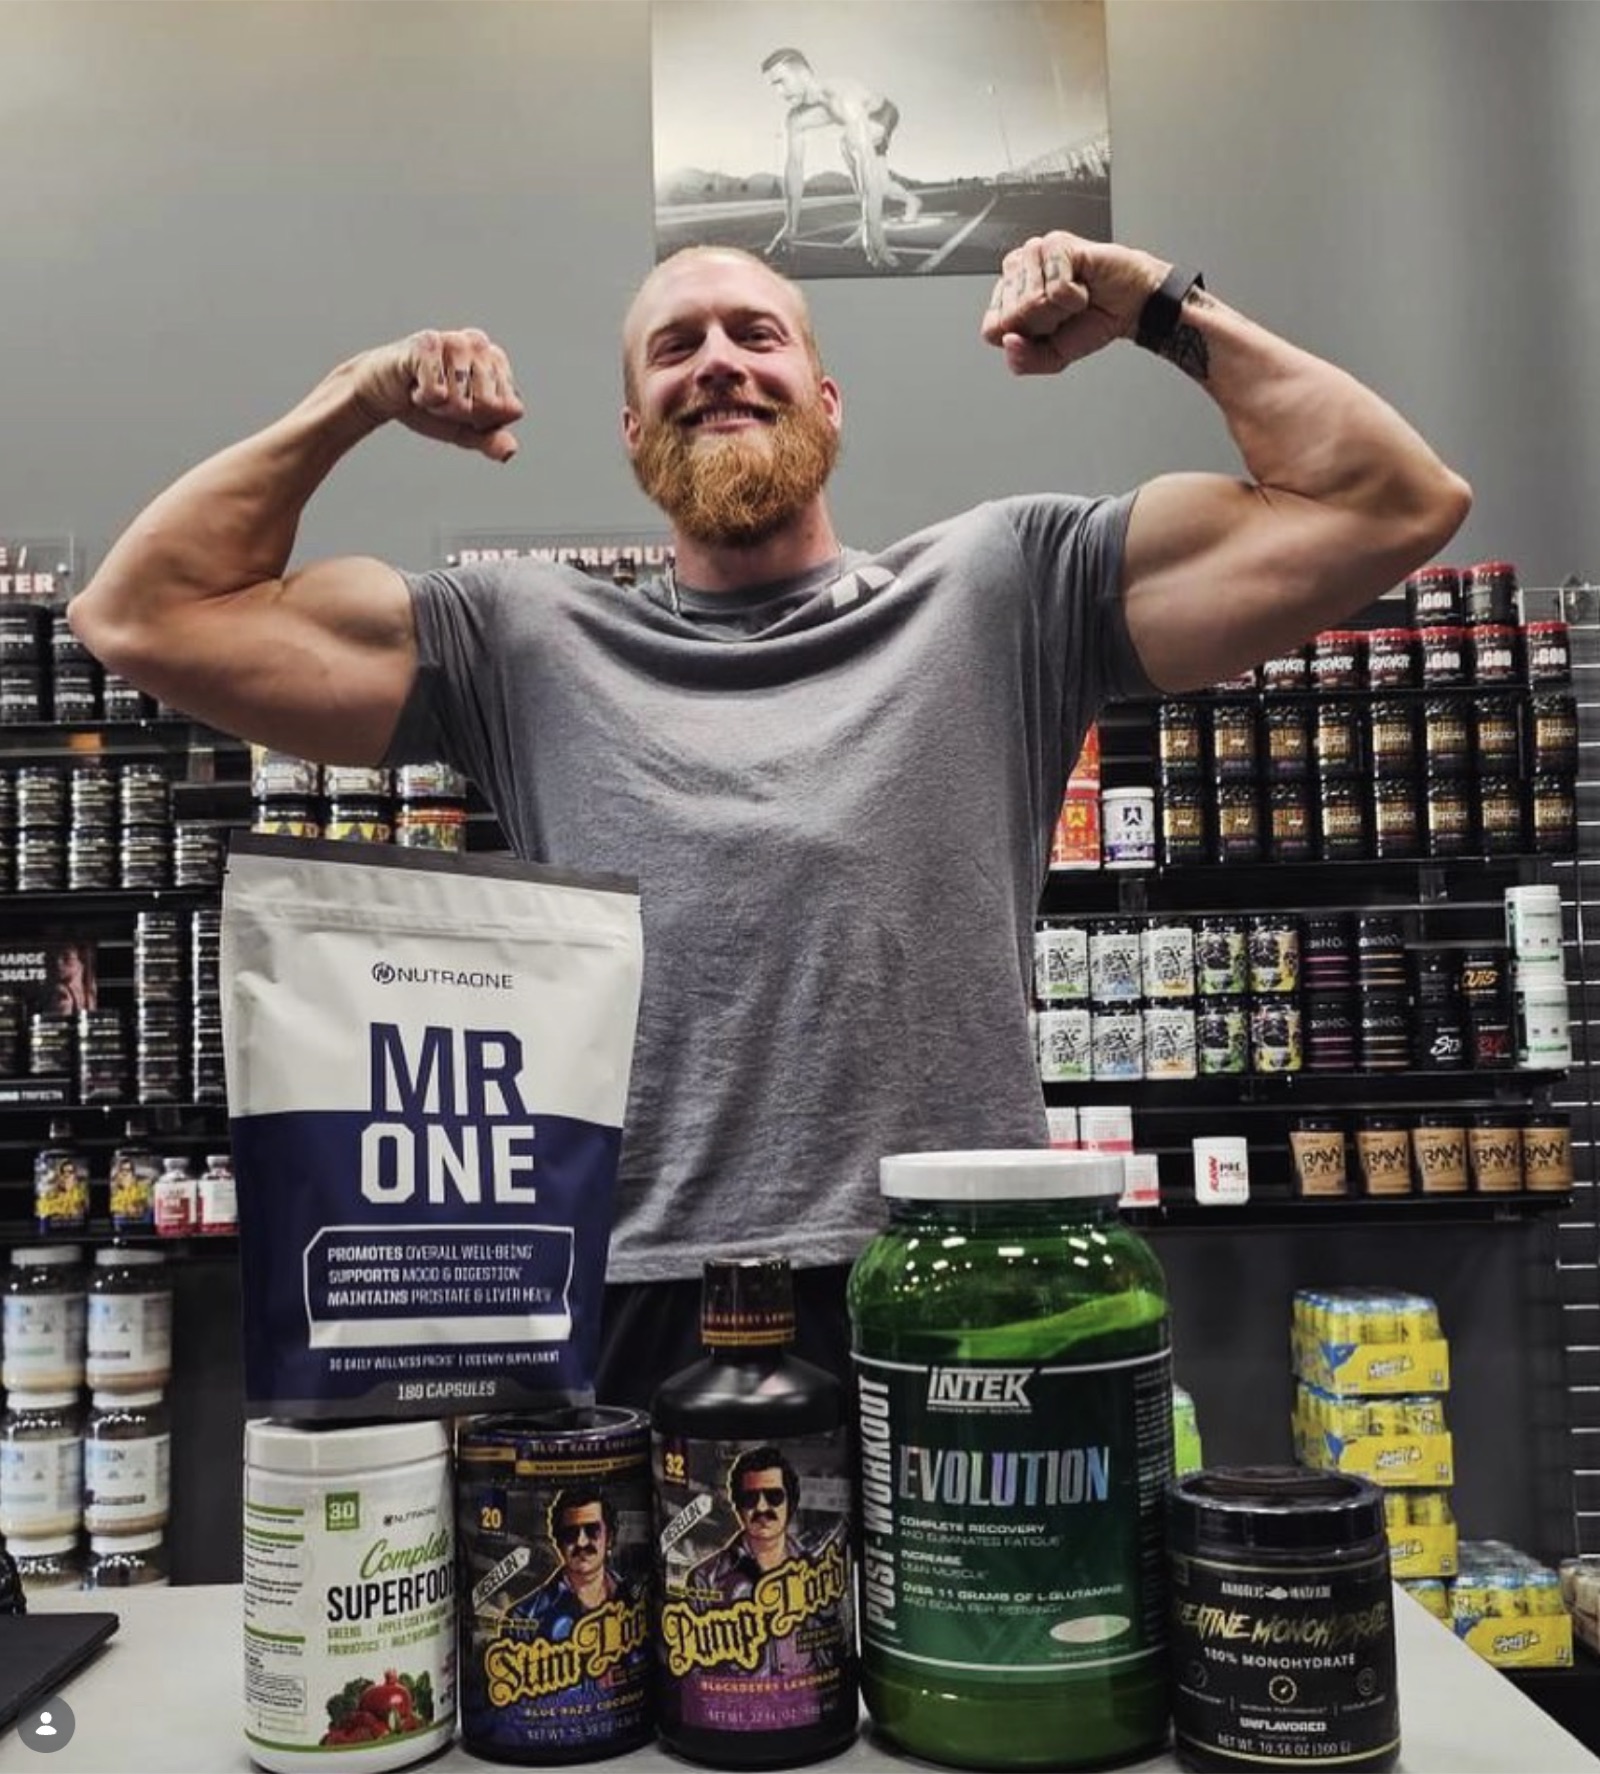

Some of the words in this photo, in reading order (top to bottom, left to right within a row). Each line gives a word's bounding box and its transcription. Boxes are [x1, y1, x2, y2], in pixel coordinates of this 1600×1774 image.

[397, 967, 513, 990] NUTRAONE
[369, 1021, 529, 1117] MR
[360, 1122, 537, 1205] ONE
[327, 1246, 404, 1263] PROMOTES
[405, 1245, 459, 1261] OVERALL
[328, 1268, 401, 1285] SUPPORTS
[402, 1267, 440, 1283] MOOD
[327, 1290, 409, 1307] MAINTAINS
[411, 1289, 471, 1305] PROSTATE
[485, 1288, 521, 1303] LIVER
[397, 1383, 424, 1401] 180
[425, 1380, 497, 1399] CAPSULES
[927, 1366, 1032, 1408] INTEK
[664, 1452, 685, 1477] 32
[899, 1445, 1111, 1507] EVOLUTION
[329, 1500, 356, 1520] 30
[481, 1506, 503, 1530] 20
[900, 1515, 964, 1533] COMPLETE
[968, 1522, 1046, 1535] RECOVERY
[901, 1549, 963, 1567] INCREASE
[902, 1580, 934, 1597] OVER
[957, 1590, 1010, 1602] GRAMS
[1013, 1591, 1034, 1603] OF
[661, 1601, 768, 1676] Pump
[1203, 1645, 1238, 1665] 100%
[1241, 1652, 1356, 1670] MONOHYDRATE
[700, 1680, 779, 1695] BLACKBERRY
[525, 1705, 556, 1718] BLUE
[1238, 1716, 1327, 1734] UNFLAVORED
[1217, 1731, 1236, 1748] NET
[1293, 1742, 1311, 1756] OZ
